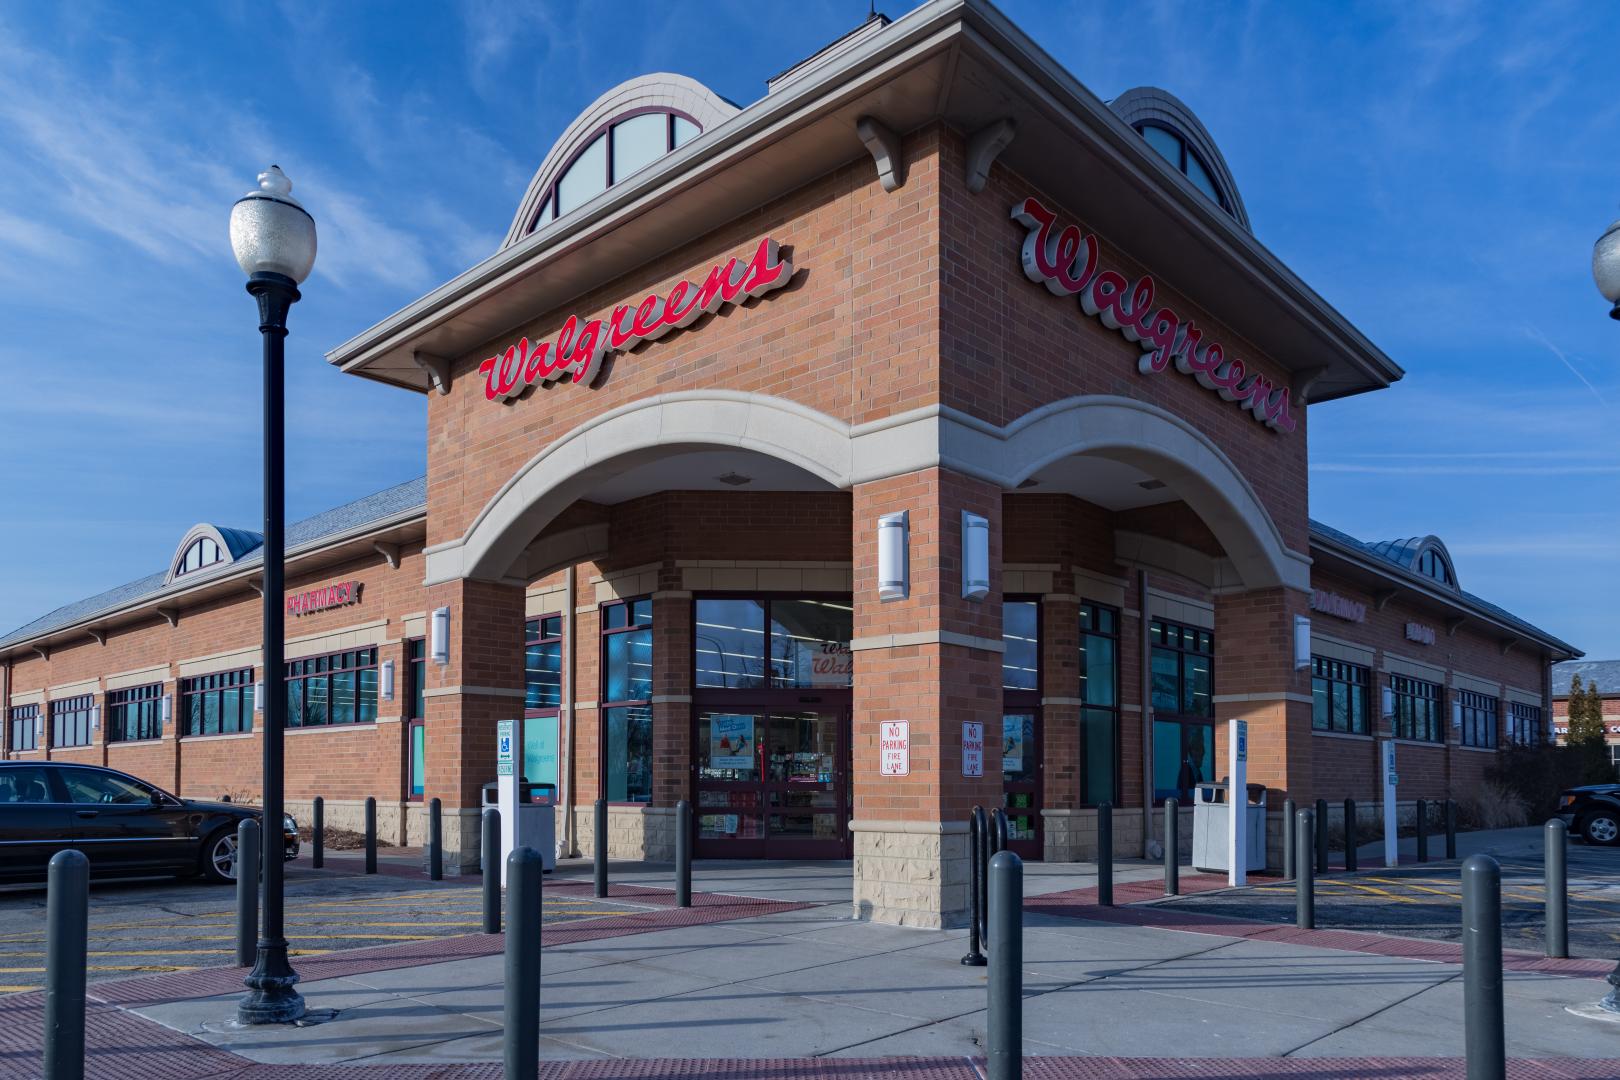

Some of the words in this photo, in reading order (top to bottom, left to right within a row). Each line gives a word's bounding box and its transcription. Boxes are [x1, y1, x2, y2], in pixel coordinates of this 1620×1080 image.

[477, 236, 787, 401] Walgreens
[1016, 196, 1296, 433] Walgreens
[287, 581, 355, 613] PHARMACY
[888, 727, 900, 737] NO
[968, 728, 977, 738] NO
[882, 740, 907, 750] PARKING
[887, 752, 901, 760] FIRE
[886, 762, 902, 770] LANE
[967, 763, 978, 771] LANE
